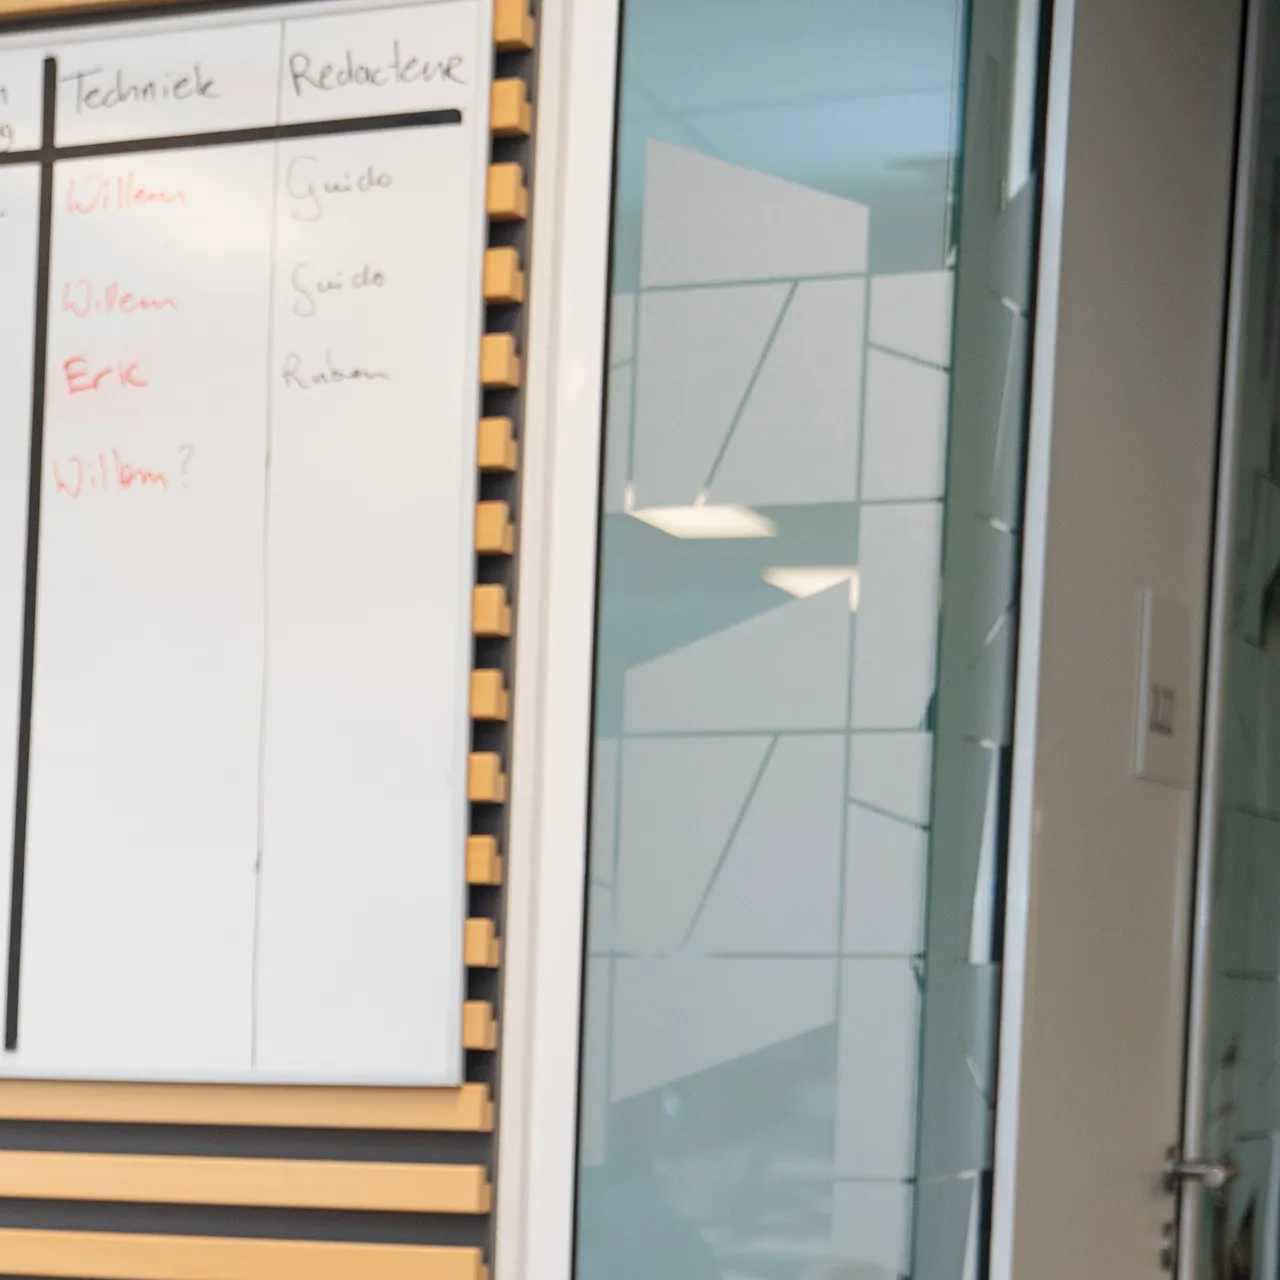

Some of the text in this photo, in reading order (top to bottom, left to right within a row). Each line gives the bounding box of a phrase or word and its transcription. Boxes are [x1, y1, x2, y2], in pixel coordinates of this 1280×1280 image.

[63, 65, 221, 114] Techniek
[65, 172, 187, 214] Willem
[286, 155, 392, 222] Guido
[61, 277, 179, 318] Willem
[291, 262, 385, 318] Guido
[63, 354, 150, 394] Eric
